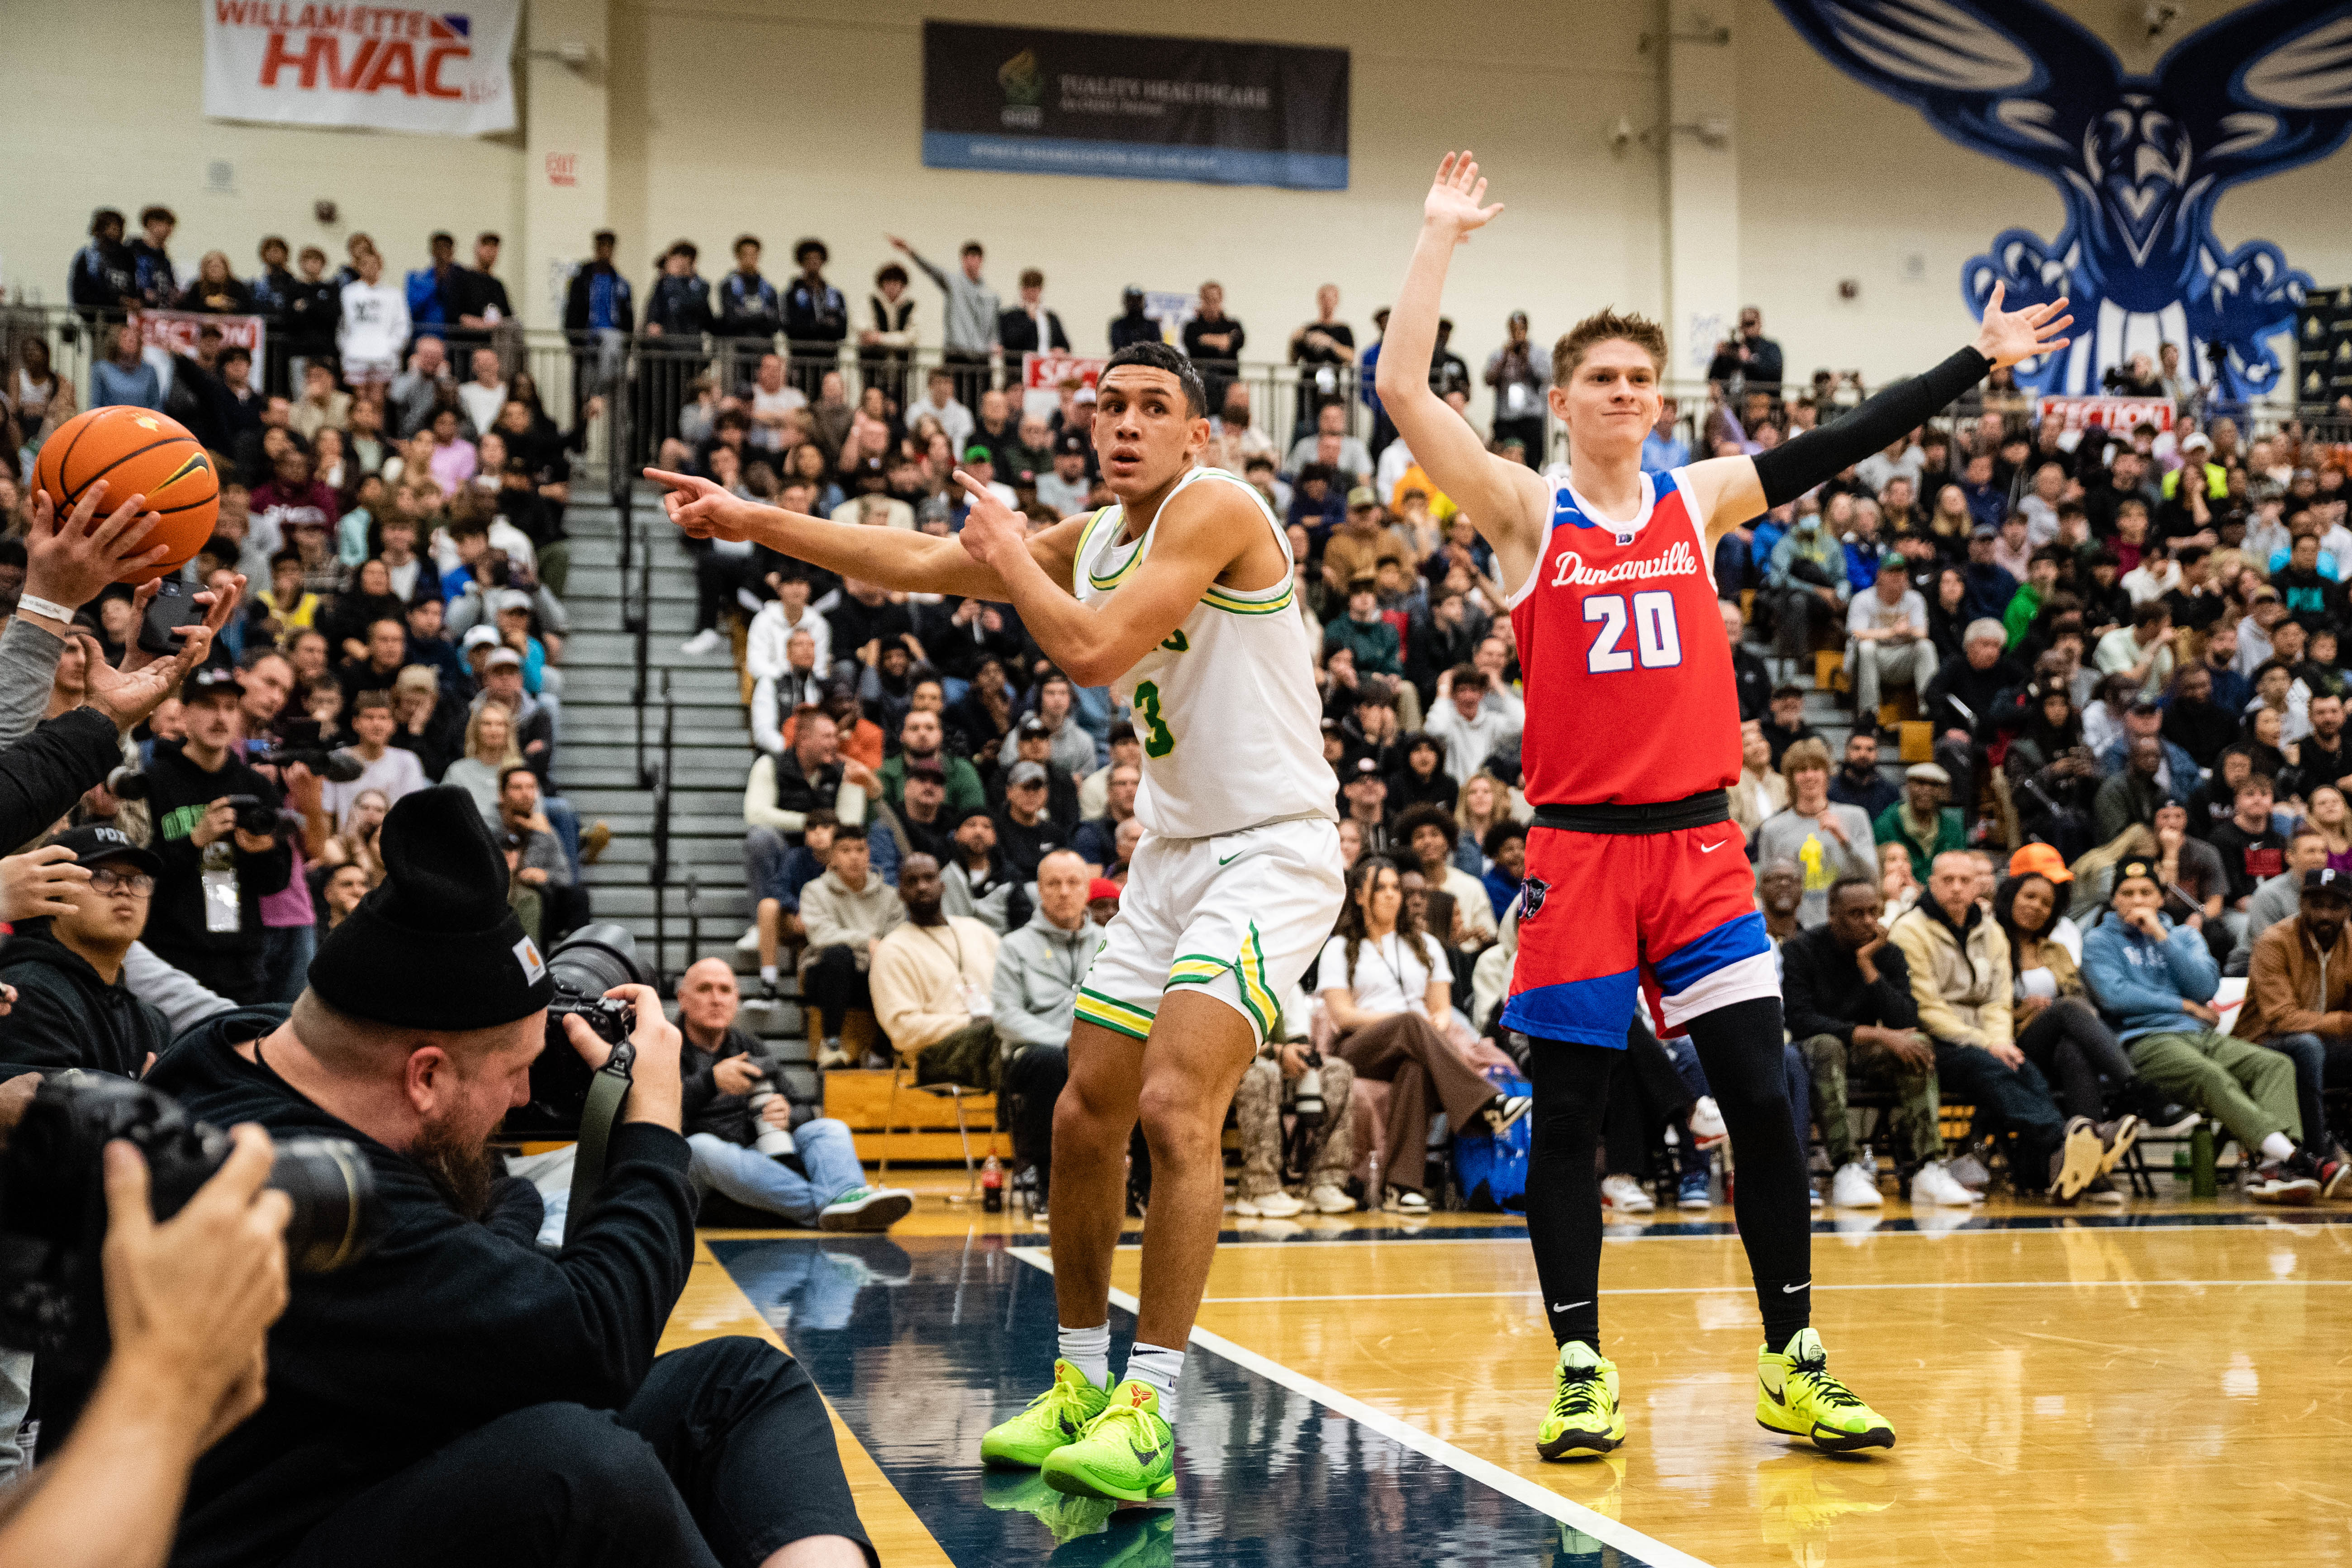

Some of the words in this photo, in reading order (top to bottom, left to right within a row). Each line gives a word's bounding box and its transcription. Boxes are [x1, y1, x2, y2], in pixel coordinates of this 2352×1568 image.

[216, 0, 424, 38] WILLAMETTE
[257, 32, 470, 99] HVAC
[1552, 541, 1697, 587] Duncanville
[1582, 589, 1682, 675] 20
[1134, 680, 1175, 758] 3
[95, 827, 130, 846] PDX
